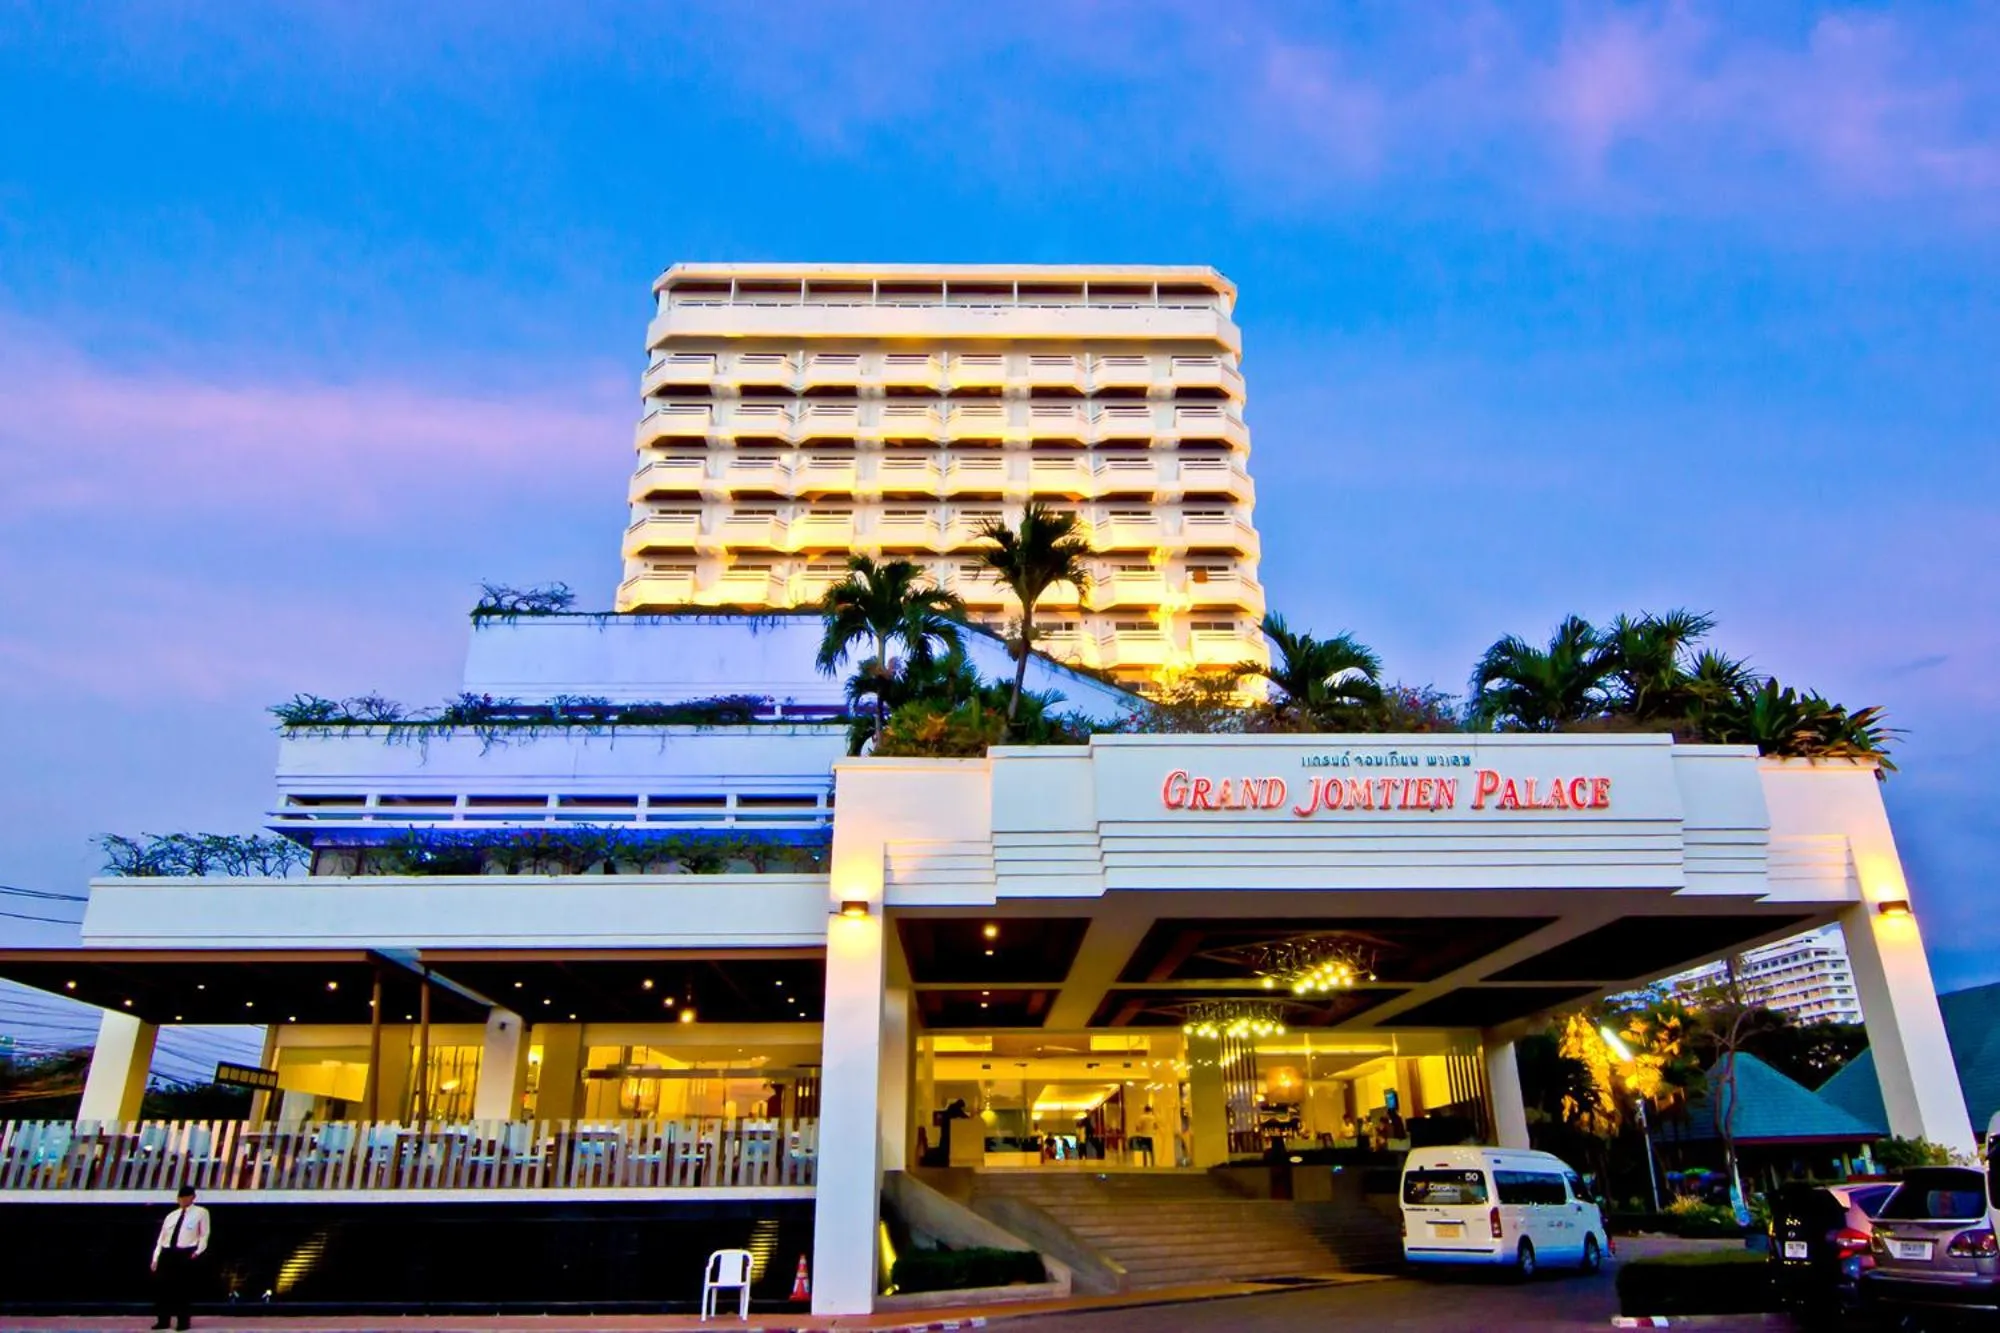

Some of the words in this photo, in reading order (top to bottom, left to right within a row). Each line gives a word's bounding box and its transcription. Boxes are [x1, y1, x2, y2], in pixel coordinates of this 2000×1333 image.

[1161, 768, 1287, 811] GRAND
[1293, 775, 1458, 818] JOMTIEN
[1471, 768, 1612, 811] PALACE
[1464, 1172, 1479, 1181] 50
